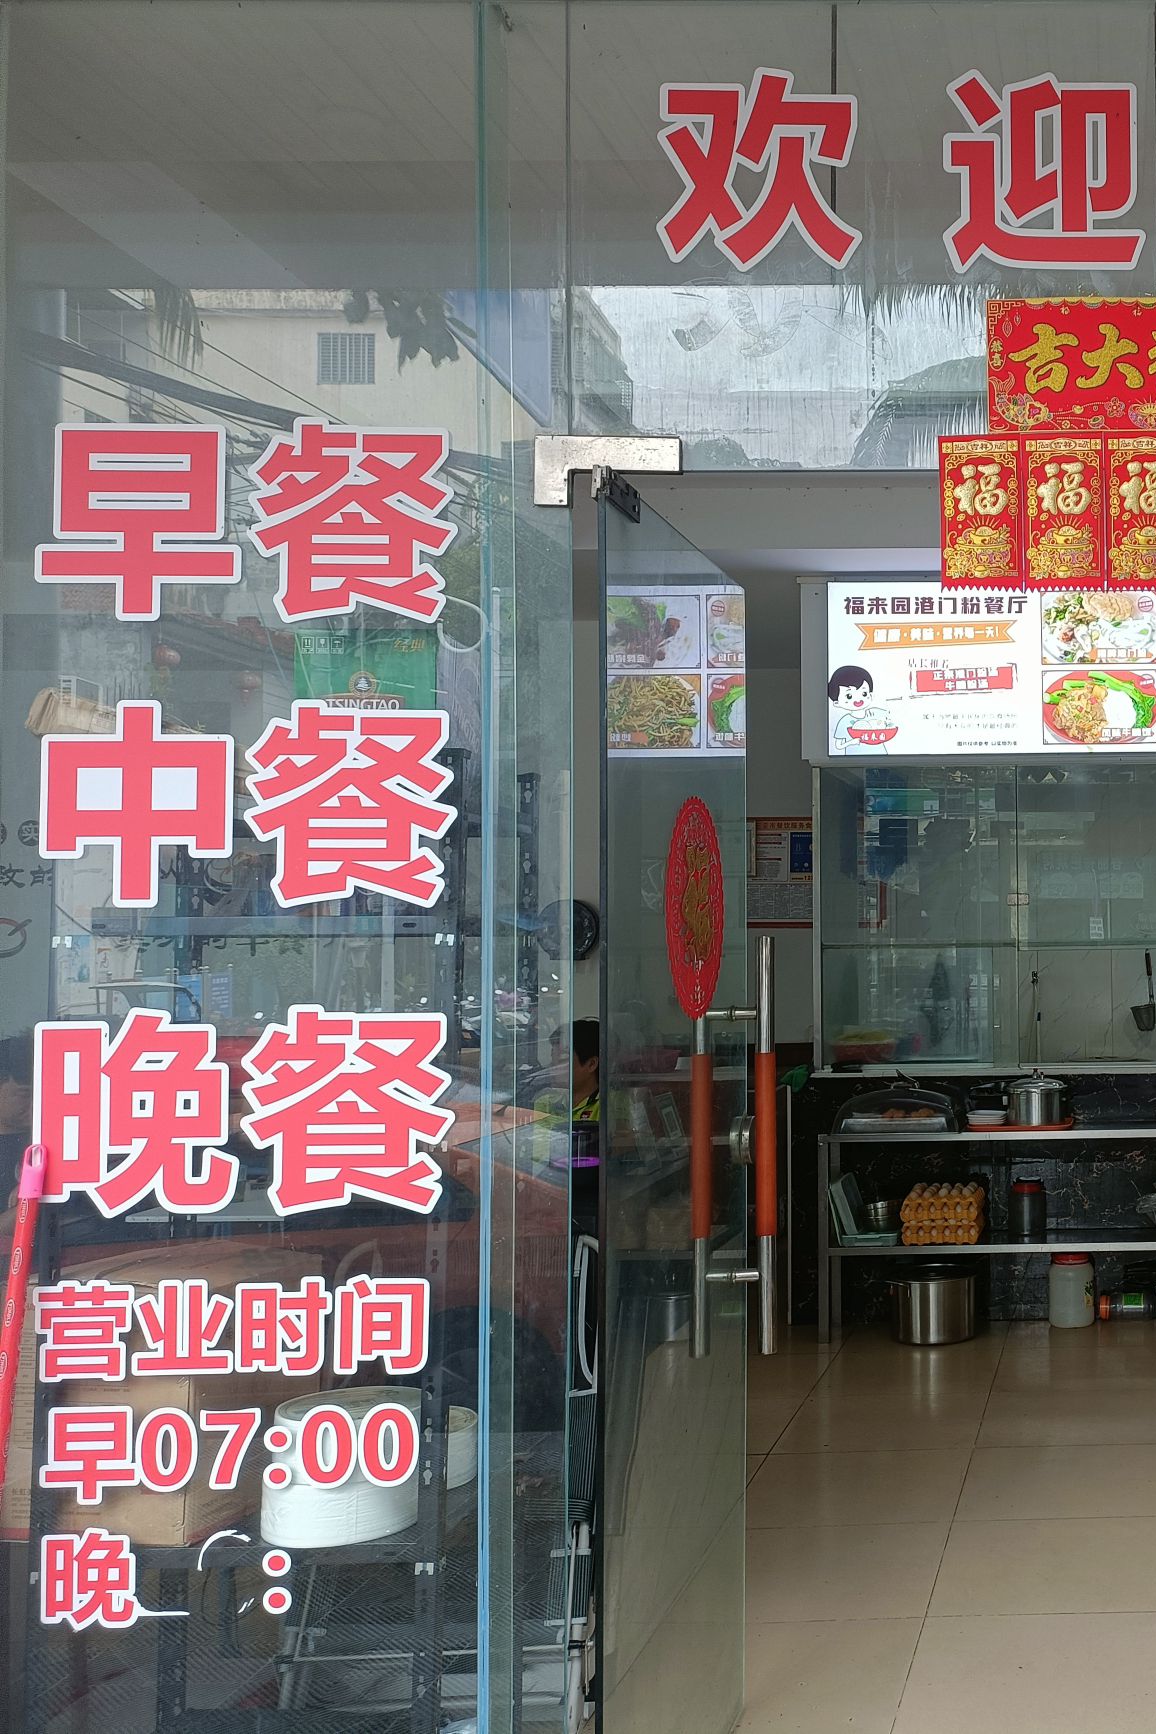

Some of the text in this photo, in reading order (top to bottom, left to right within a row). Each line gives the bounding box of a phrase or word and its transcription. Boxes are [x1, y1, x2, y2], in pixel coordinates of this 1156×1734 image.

[34, 417, 459, 623] 早餐
[954, 463, 1010, 516] 福
[1037, 462, 1093, 515] 福
[844, 596, 1028, 615] 福来园港门粉餐厅
[39, 699, 456, 909] 中餐
[32, 1004, 455, 1216] 晚餐
[34, 1275, 430, 1384] 营业时间
[39, 1403, 420, 1506] 早07:00
